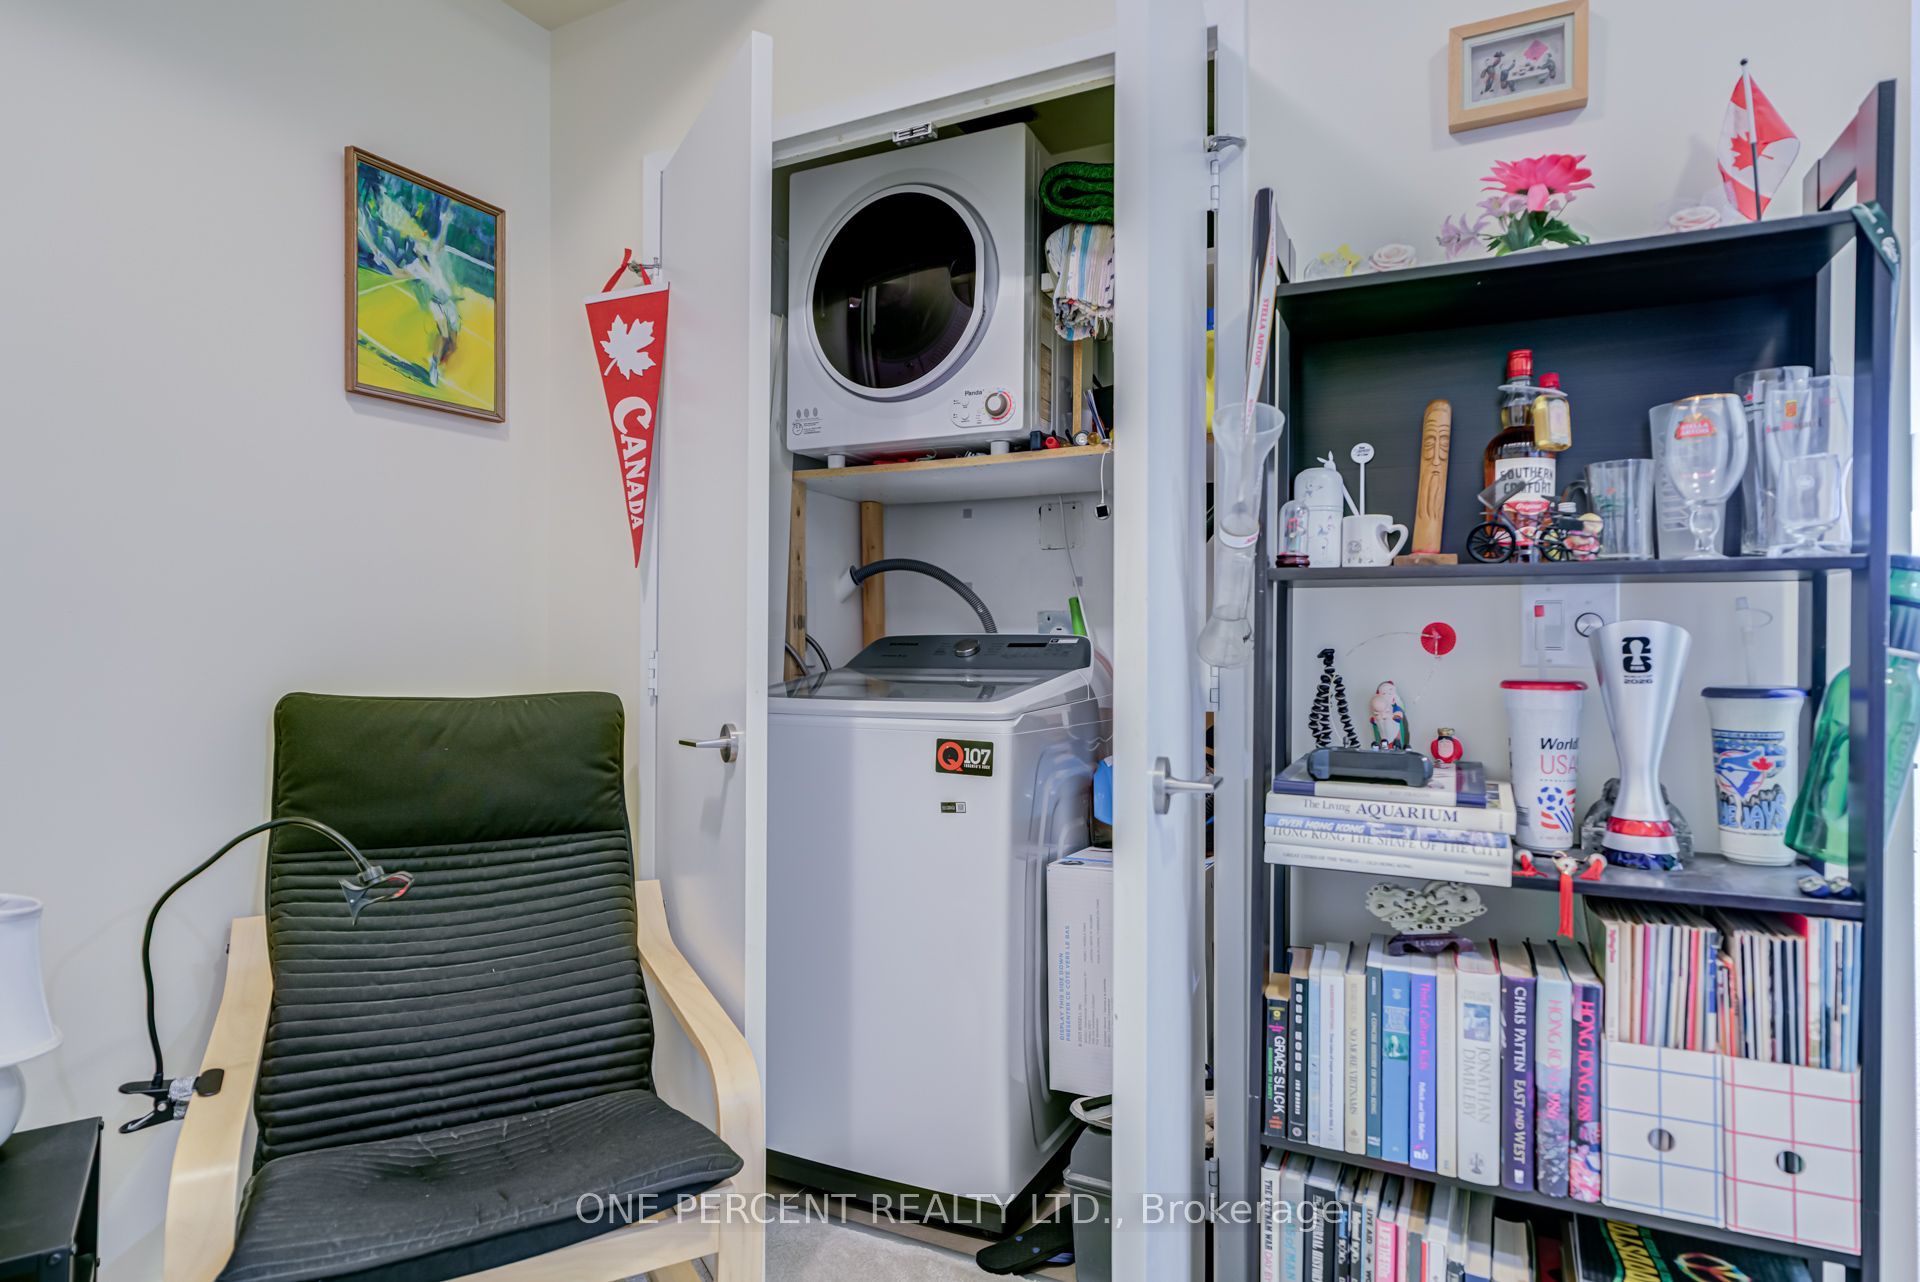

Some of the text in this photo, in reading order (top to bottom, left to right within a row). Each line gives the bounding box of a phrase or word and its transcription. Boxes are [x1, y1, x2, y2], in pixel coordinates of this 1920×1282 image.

[1254, 298, 1270, 368] STELLA ARTOIS
[964, 747, 991, 765] 107
[1277, 818, 1304, 828] OVER
[1305, 820, 1334, 831] HONG
[1334, 822, 1366, 834] KONG
[1303, 798, 1459, 823] The Living AQUARIUM
[1271, 826, 1504, 857] HONG KONG THE SHAPE OF THE CITY
[1513, 986, 1527, 1072] CHRIS PATTEN
[1547, 999, 1562, 1044] HONG
[1578, 1000, 1595, 1047] HONG
[1273, 1035, 1286, 1114] GRACE SLICK
[1463, 1047, 1476, 1120] DIMBLEBY
[1476, 1046, 1491, 1124] JONATHAN
[1577, 1049, 1595, 1093] KONG
[1513, 1079, 1526, 1164] EAST AND WEST
[1264, 1180, 1273, 1196] THE
[1264, 1197, 1273, 1231] VIETNAM
[1264, 1233, 1273, 1251] WAR
